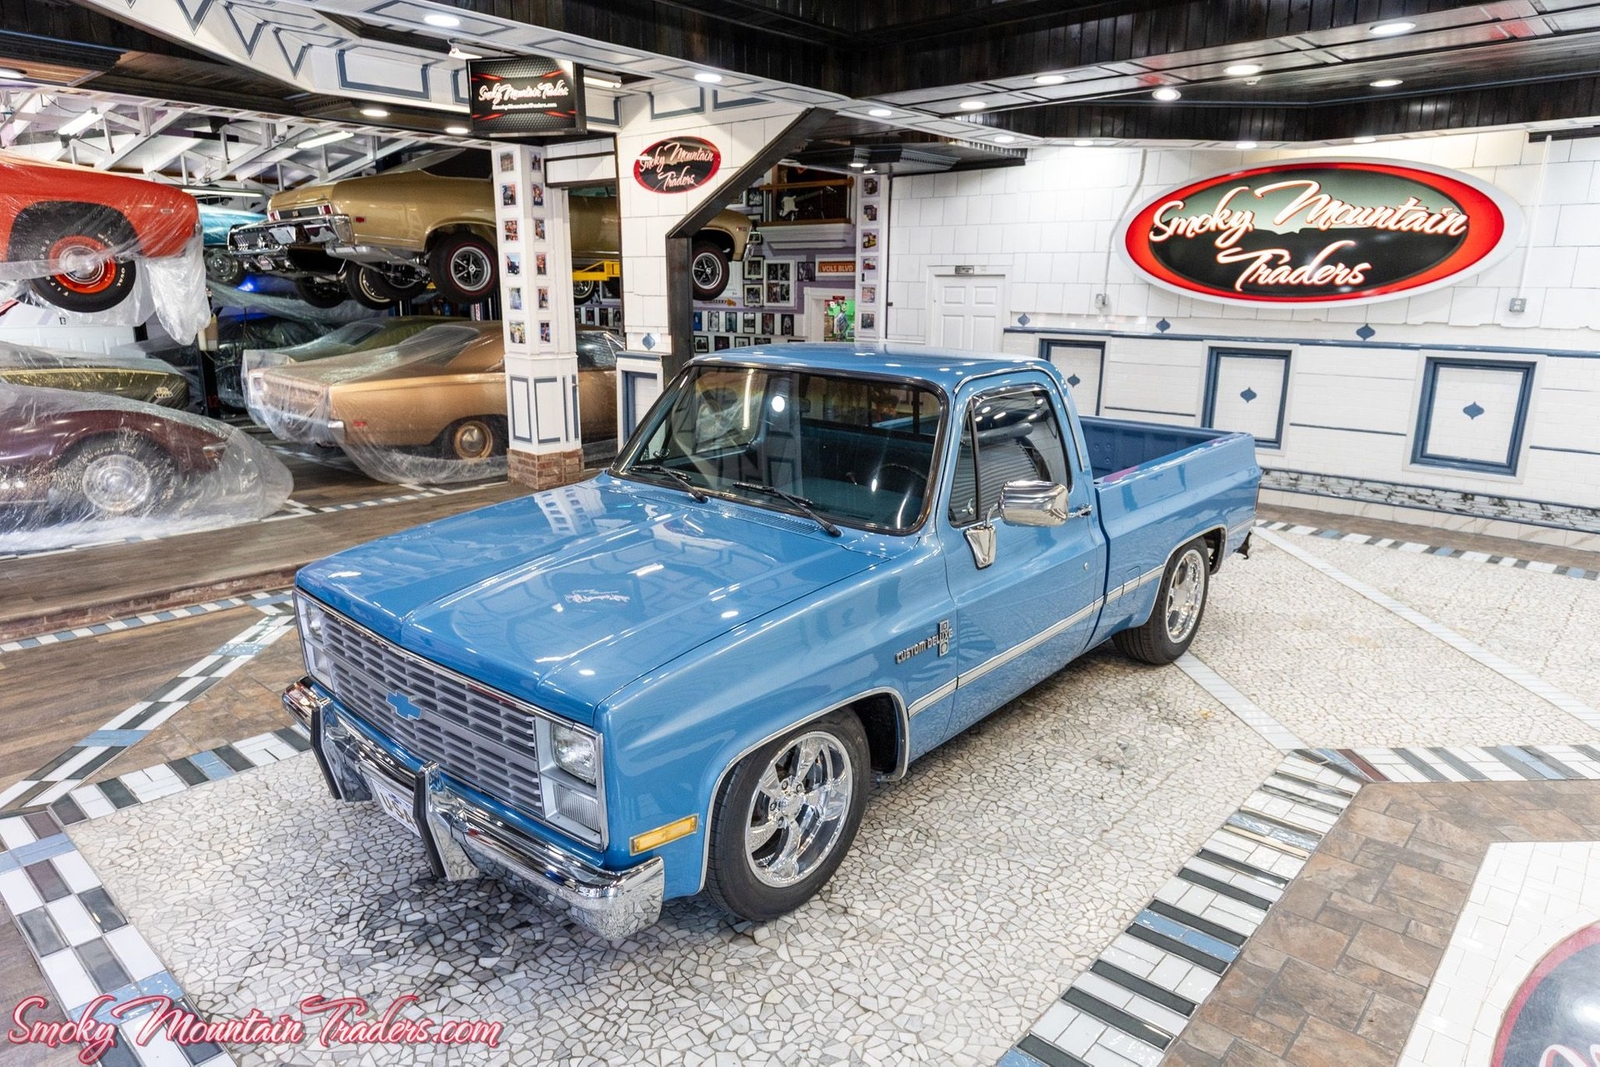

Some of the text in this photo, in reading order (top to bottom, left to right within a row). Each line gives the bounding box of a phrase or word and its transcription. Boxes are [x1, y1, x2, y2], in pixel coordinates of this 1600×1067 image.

[478, 82, 503, 105] Smoky
[639, 142, 715, 173] Smoky Mountain
[657, 165, 696, 191] Traders
[1148, 179, 1470, 248] Smoky Mountain
[1216, 240, 1373, 292] Traders
[896, 627, 954, 664] CUSTOM DELUXE
